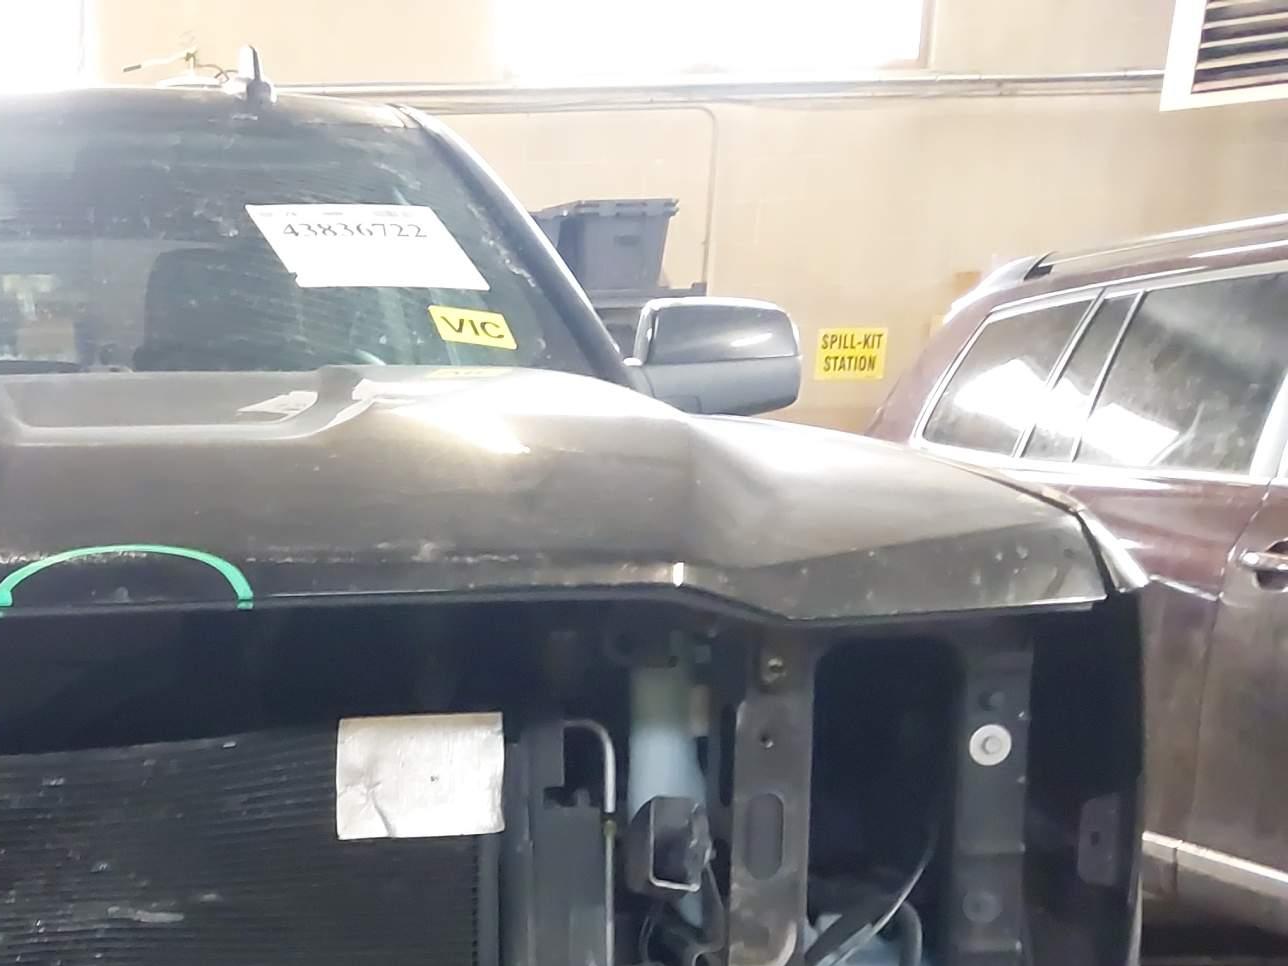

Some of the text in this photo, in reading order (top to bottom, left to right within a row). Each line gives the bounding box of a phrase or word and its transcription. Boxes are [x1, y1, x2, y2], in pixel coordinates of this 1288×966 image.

[283, 222, 427, 238] 43836722
[440, 315, 505, 340] VIC
[821, 333, 884, 350] SPILL-KIT
[823, 355, 877, 372] STATION
